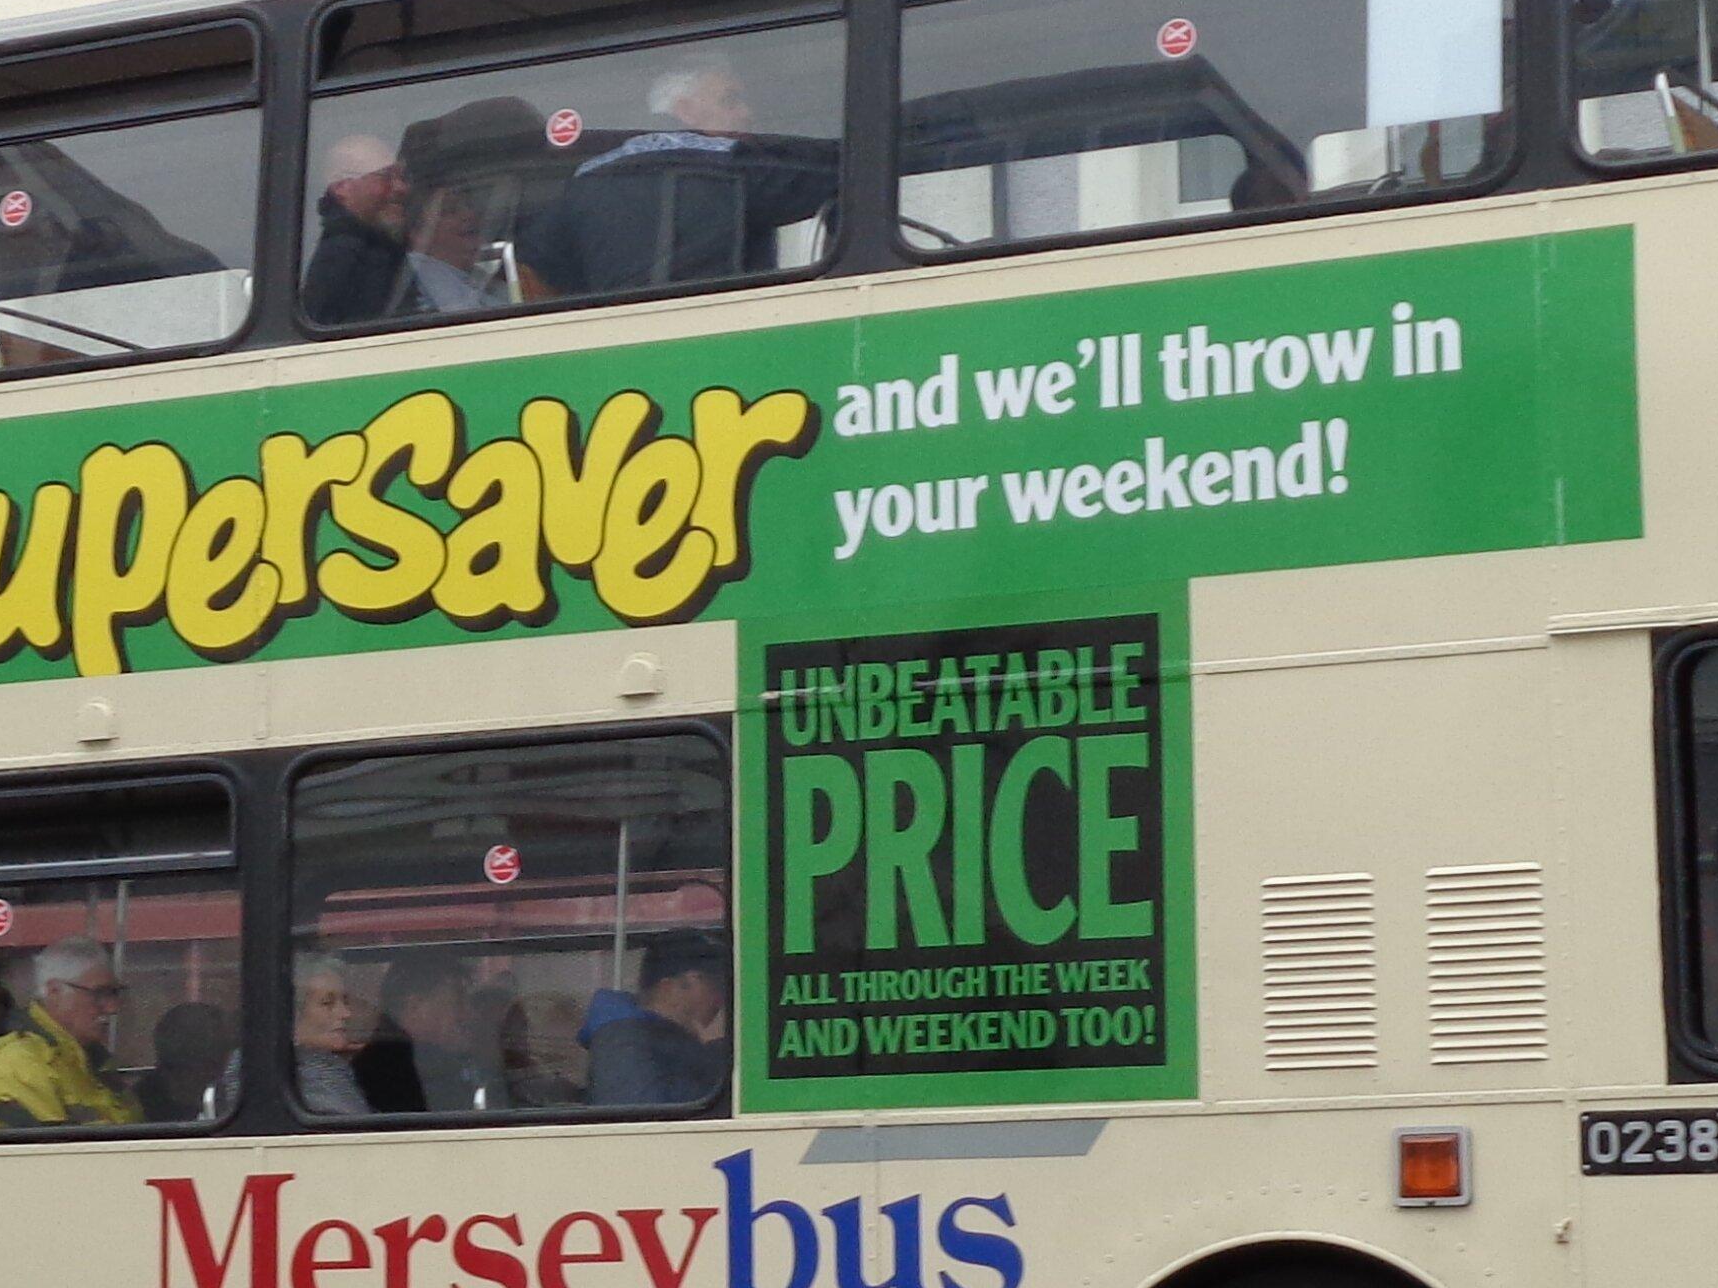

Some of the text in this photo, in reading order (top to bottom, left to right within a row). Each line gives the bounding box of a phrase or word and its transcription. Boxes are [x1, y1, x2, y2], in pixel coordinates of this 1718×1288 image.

[833, 301, 1463, 437] and we'll throw in
[833, 417, 1350, 560] your weekend!
[780, 642, 1148, 746] UNBEATABLE
[783, 732, 1155, 955] PRICE
[777, 1004, 1157, 1058] AND WEEKEND TOO!
[780, 958, 1153, 1006] ALL THROUGH THE WEEK
